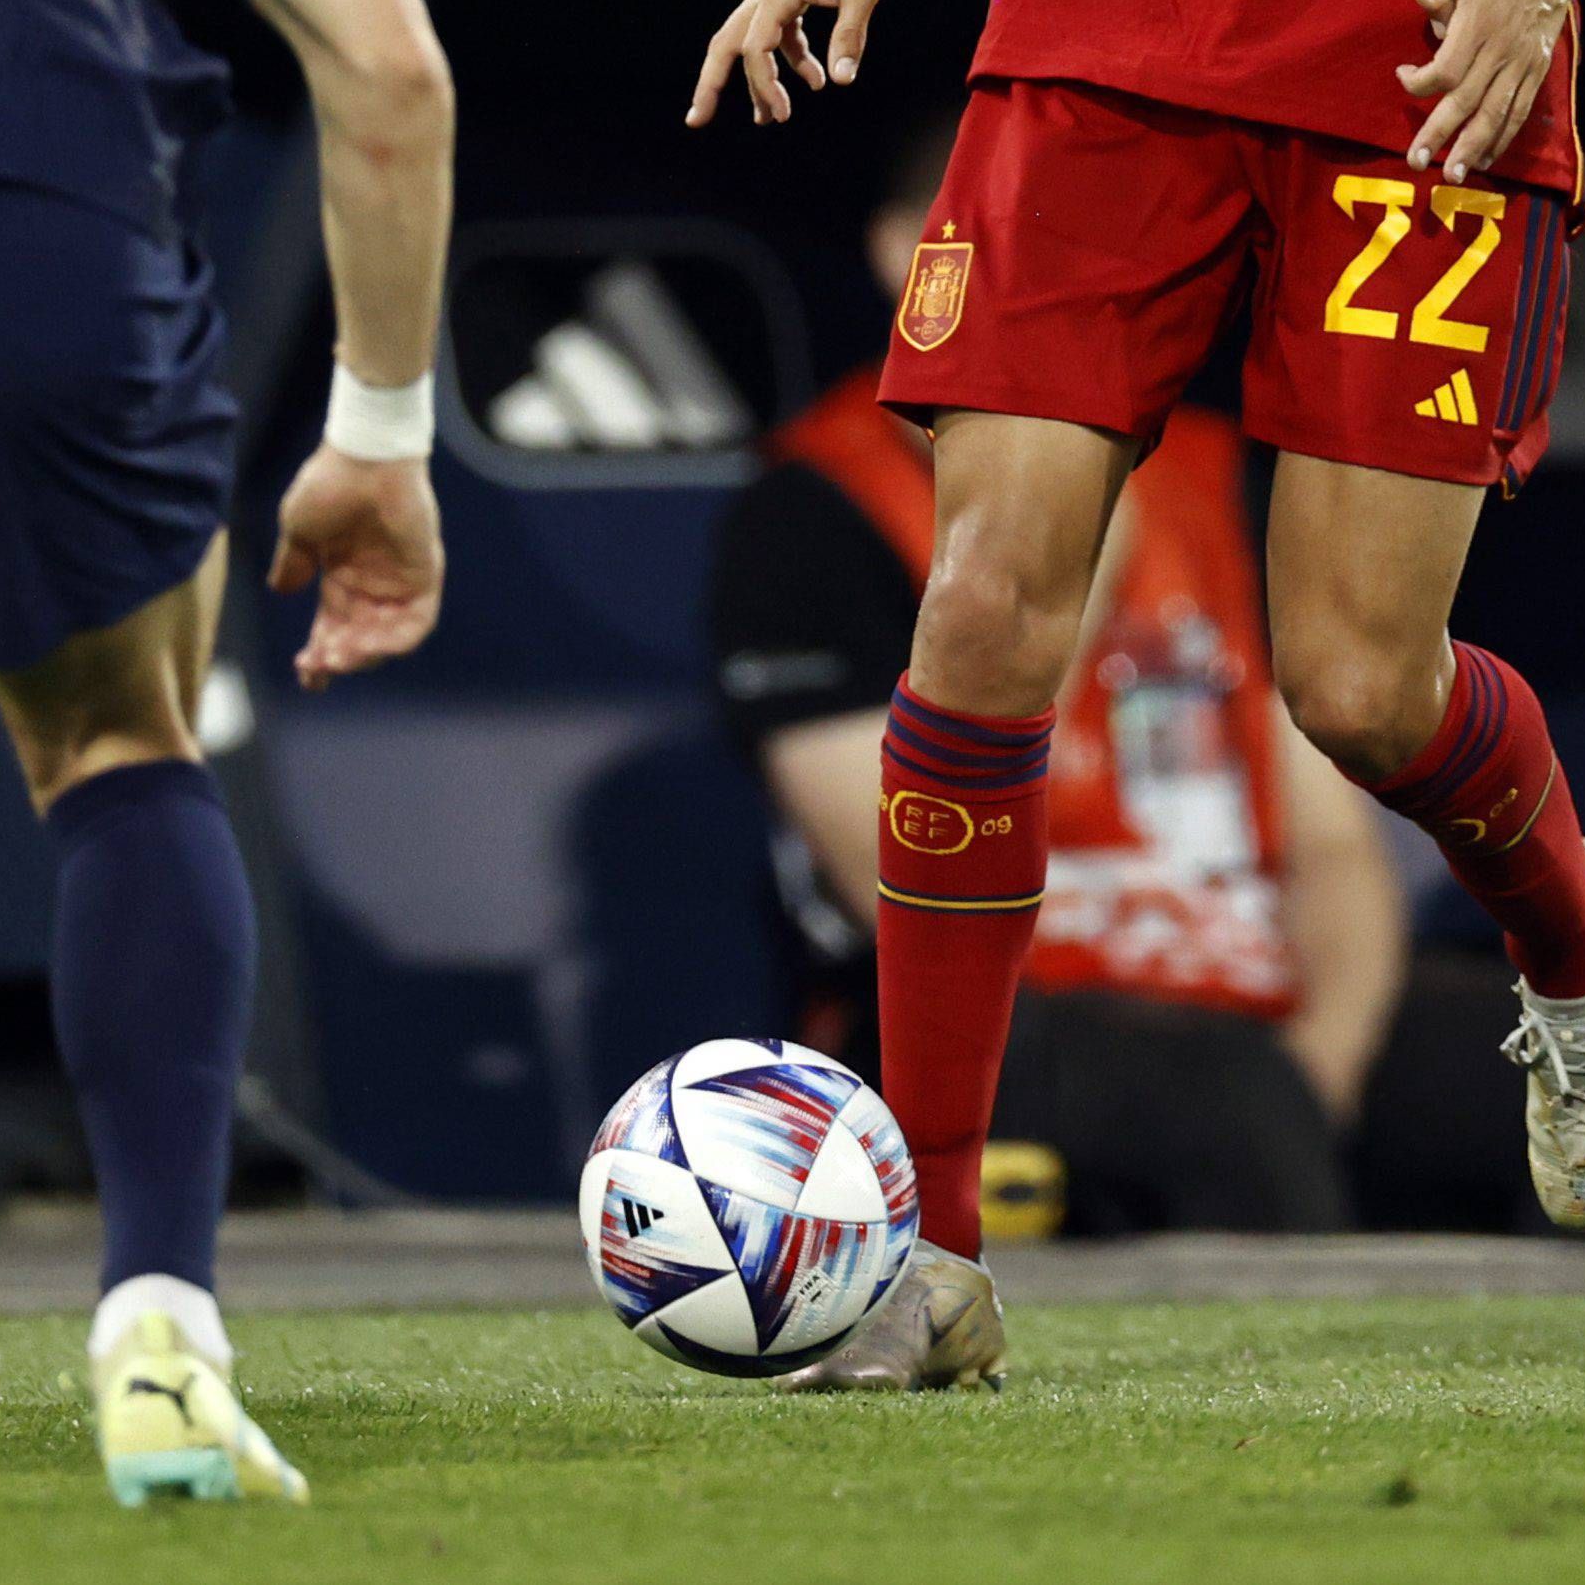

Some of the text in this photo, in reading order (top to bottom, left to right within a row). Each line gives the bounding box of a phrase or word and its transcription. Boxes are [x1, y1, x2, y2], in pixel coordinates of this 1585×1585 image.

[1323, 173, 1507, 353] 22
[980, 814, 1014, 836] 09
[799, 1275, 821, 1296] FIFA
